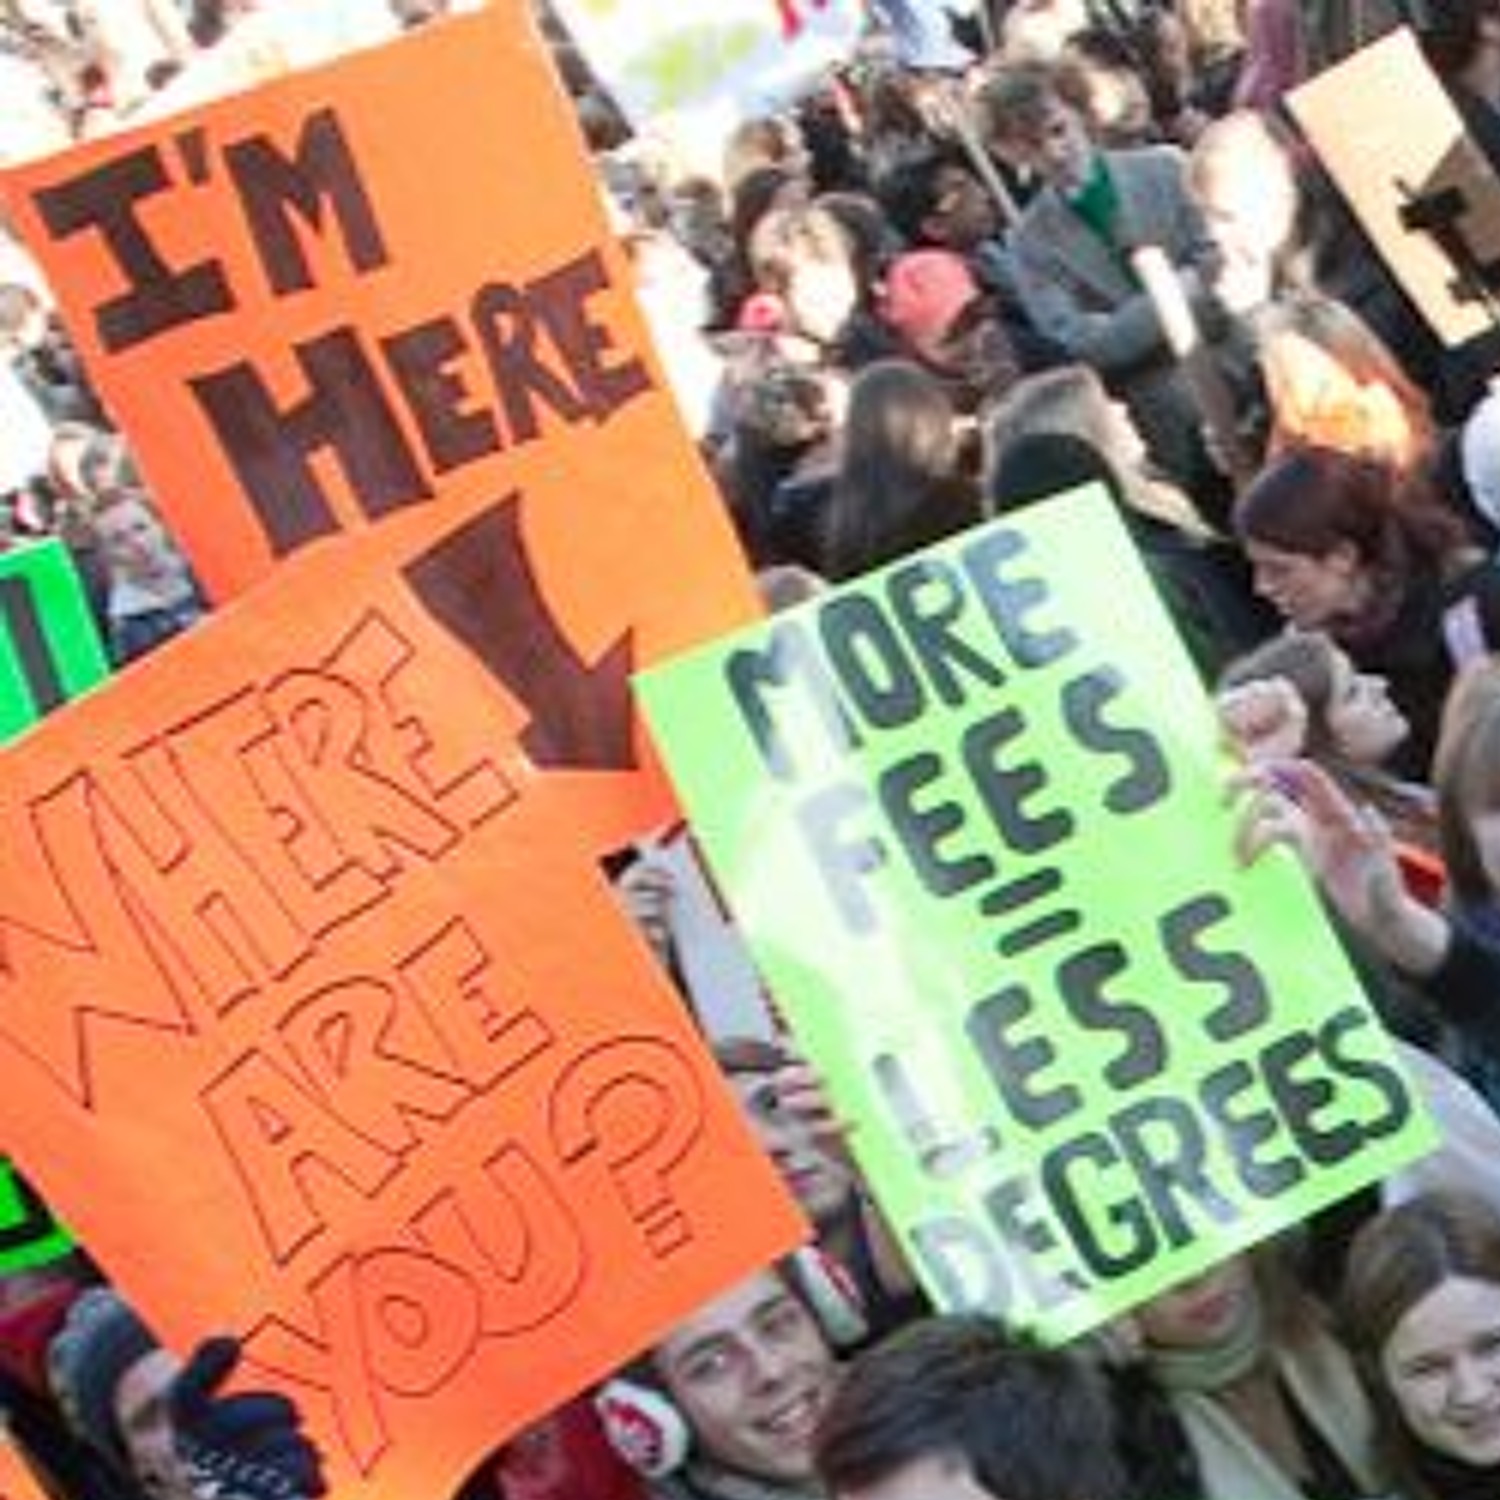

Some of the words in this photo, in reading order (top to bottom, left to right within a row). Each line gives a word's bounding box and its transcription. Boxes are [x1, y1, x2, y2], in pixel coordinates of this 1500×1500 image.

[31, 106, 388, 355] I'M
[189, 246, 654, 562] HERE
[724, 528, 1079, 782] MORE
[797, 666, 1171, 937] FEES
[0, 608, 521, 1113] WHERE
[200, 916, 557, 1266] ARE
[871, 893, 1273, 1180] LESS
[909, 1004, 1412, 1316] DEGREES
[238, 1035, 706, 1478] YOU?
